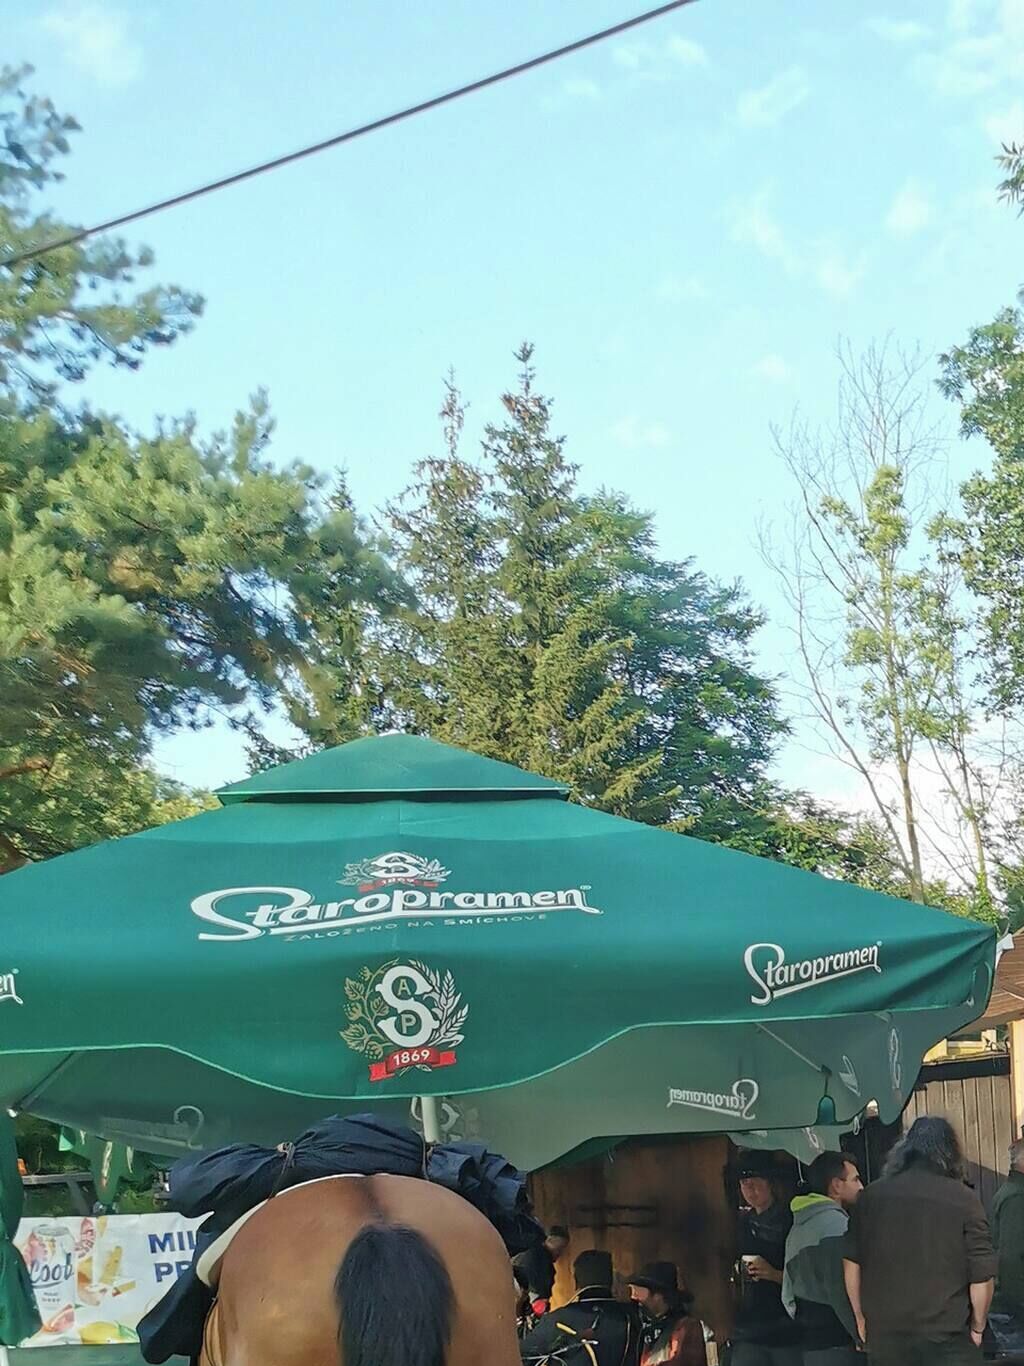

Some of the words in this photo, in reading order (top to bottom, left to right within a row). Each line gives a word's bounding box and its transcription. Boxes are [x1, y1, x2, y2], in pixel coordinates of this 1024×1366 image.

[190, 886, 604, 941] Staropramen
[408, 919, 435, 929] NA
[743, 942, 882, 1006] Staropramen
[393, 1049, 431, 1066] 1869
